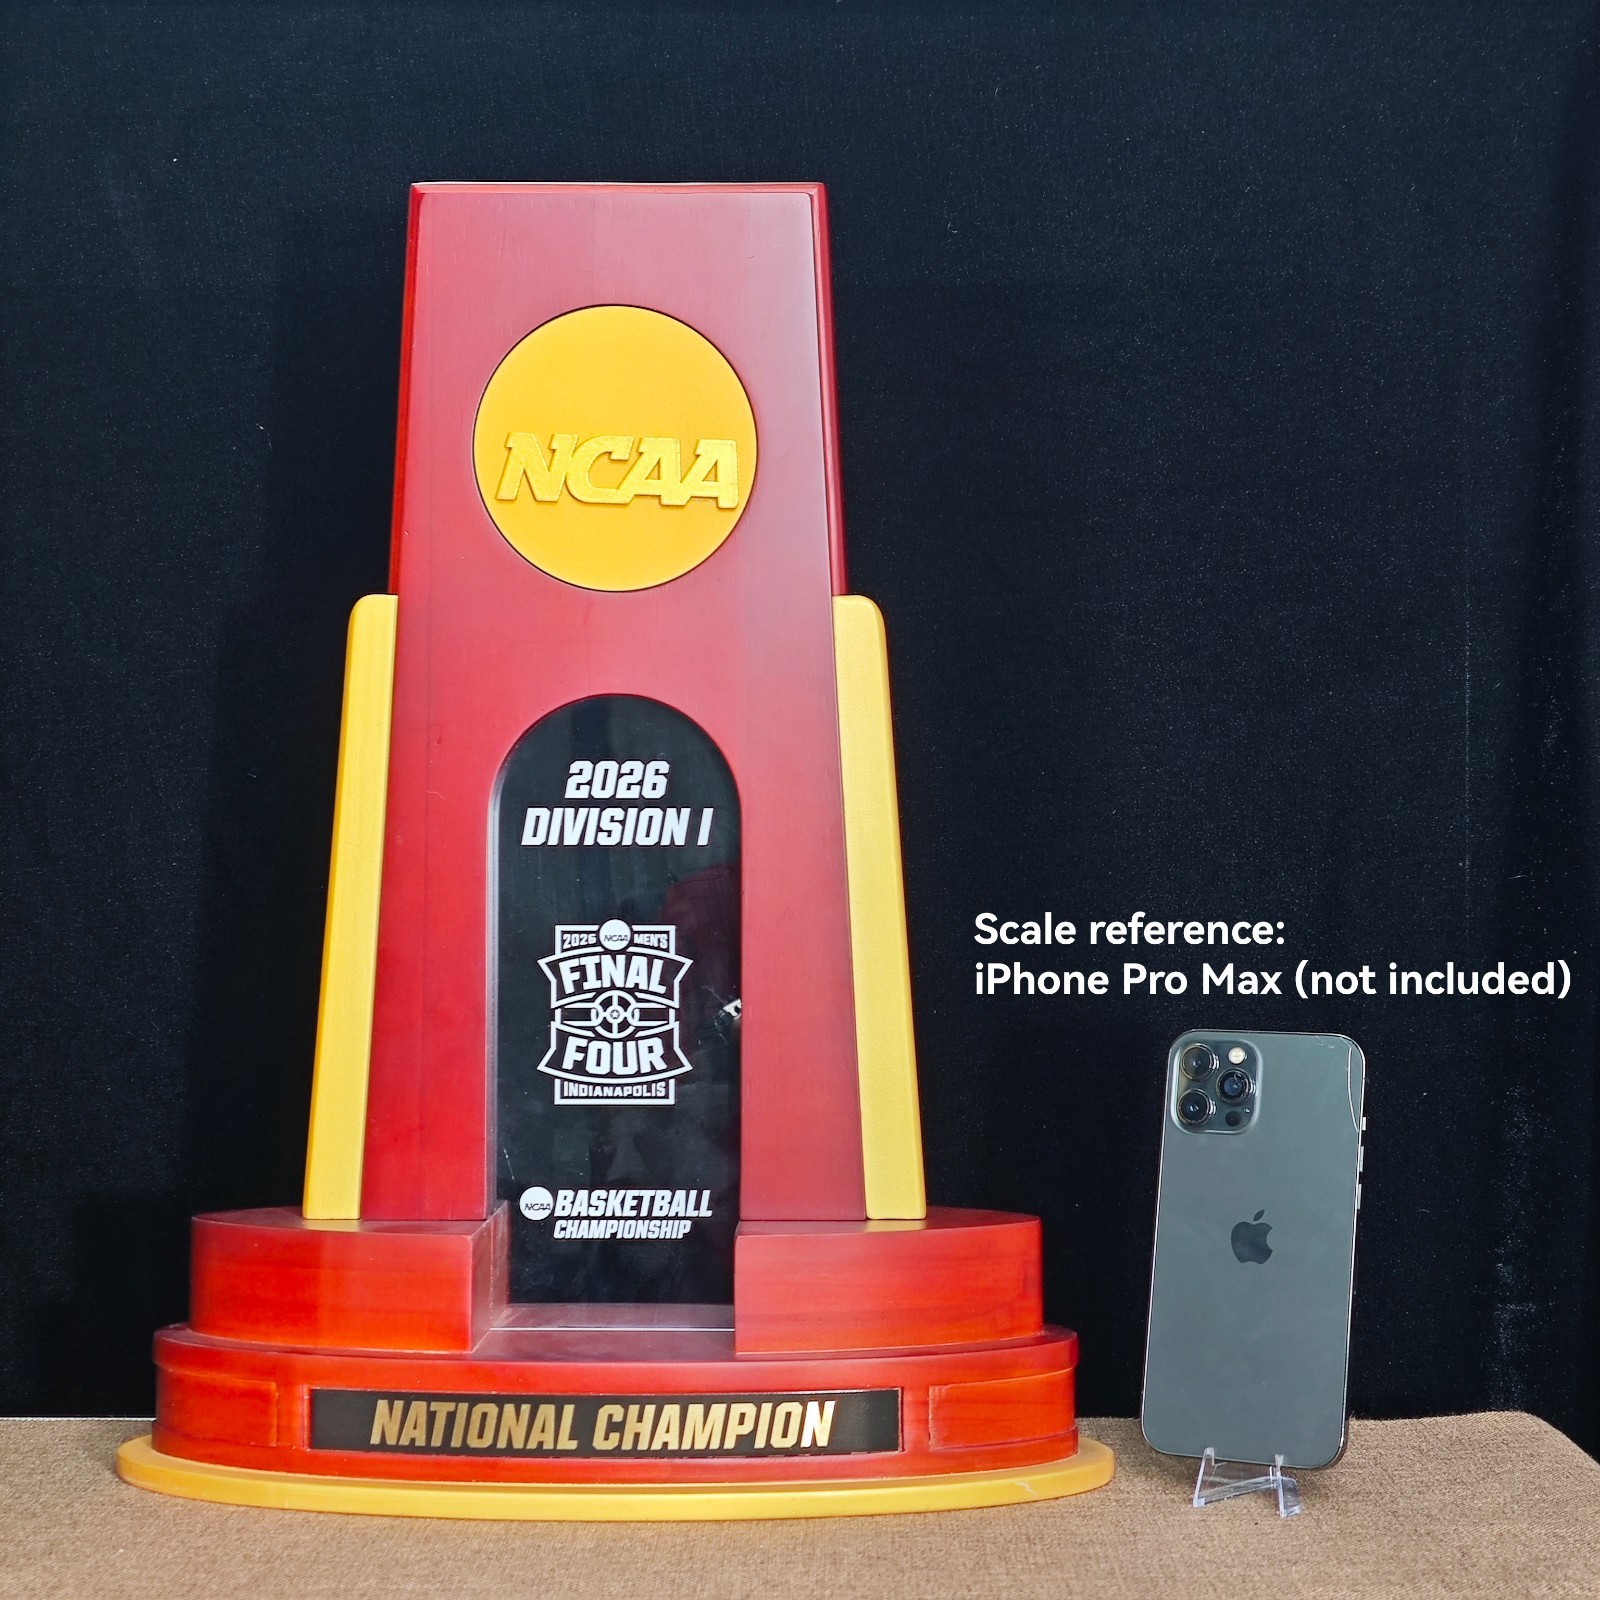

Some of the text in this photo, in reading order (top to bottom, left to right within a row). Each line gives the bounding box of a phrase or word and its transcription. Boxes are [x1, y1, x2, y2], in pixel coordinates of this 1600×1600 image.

[496, 432, 738, 509] NCAA
[564, 760, 670, 799] 2026
[521, 808, 714, 846] DIVISION I
[603, 934, 628, 942] NCAA
[633, 933, 668, 949] MEN'S
[559, 954, 667, 995] FINAL
[561, 1036, 668, 1076] FOUR
[563, 1081, 666, 1098] INDIANAPOLIS
[524, 1202, 551, 1211] NCAA
[553, 1189, 713, 1217] BASKETBALL
[553, 1219, 692, 1239] CHAMPIONSHIP
[370, 1399, 837, 1451] NATIONAL CHAMPION
